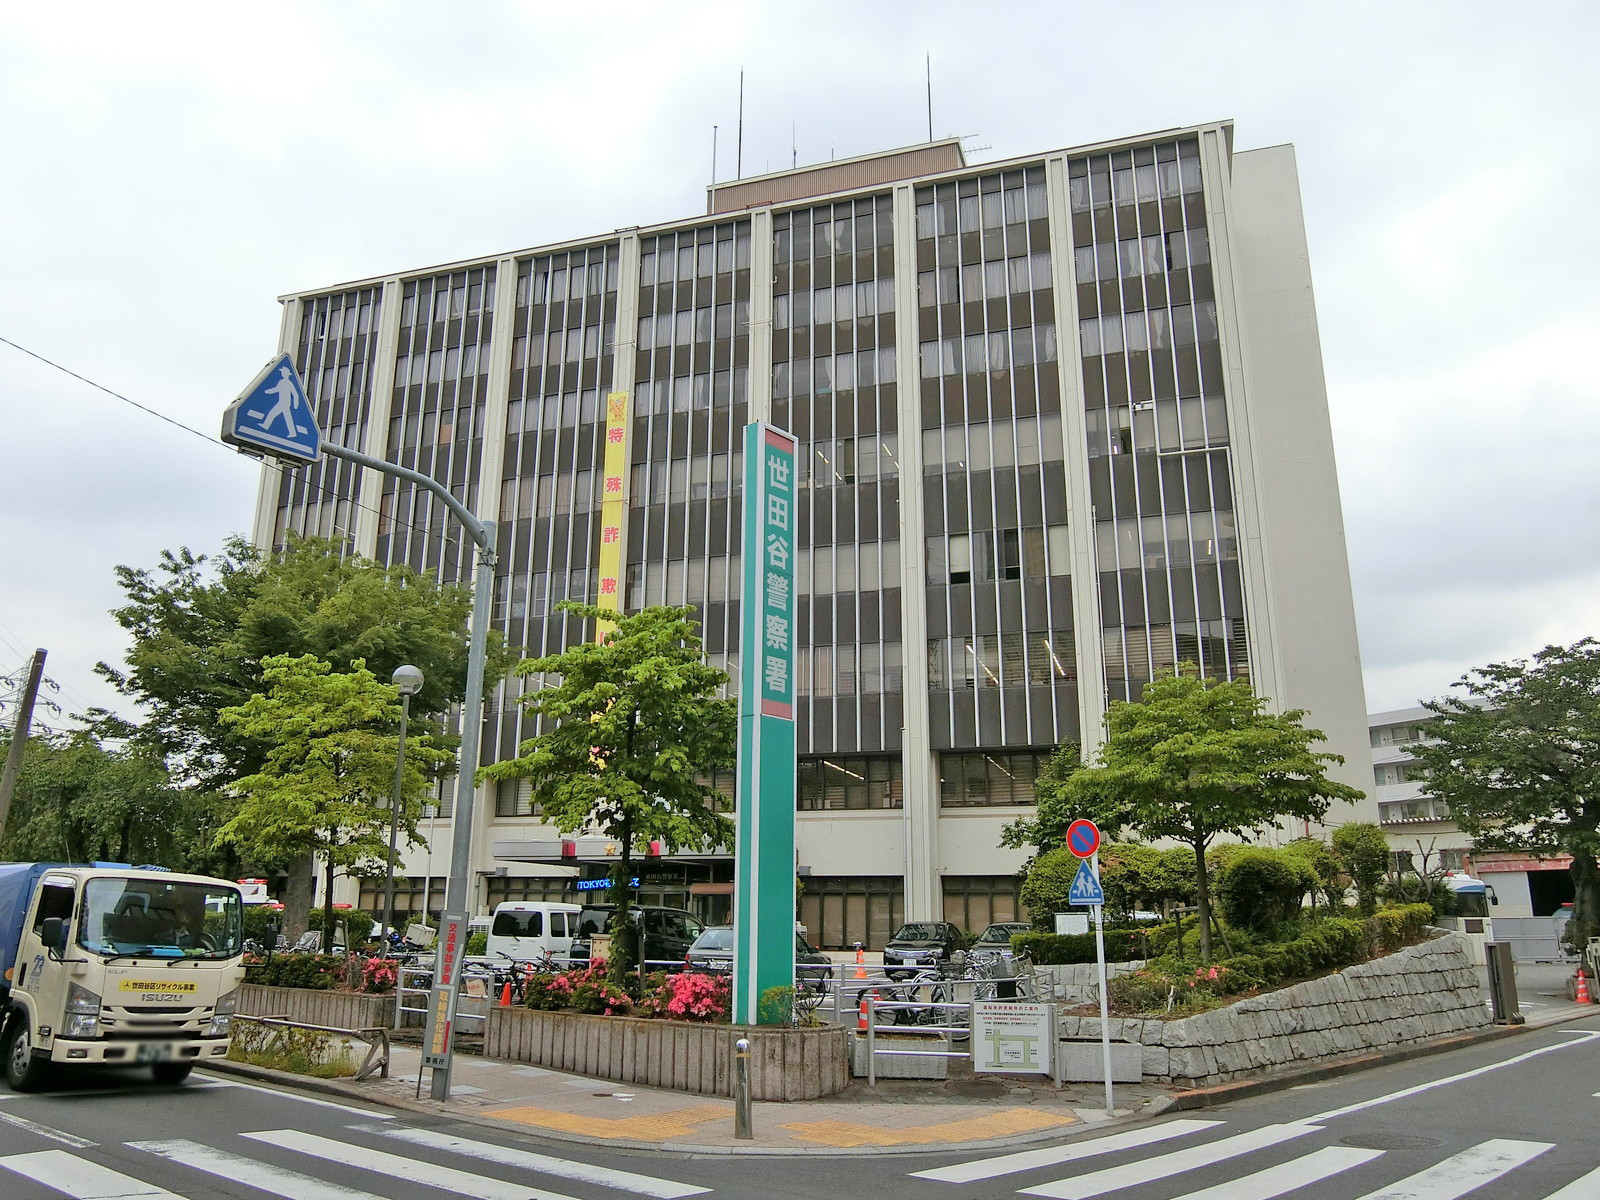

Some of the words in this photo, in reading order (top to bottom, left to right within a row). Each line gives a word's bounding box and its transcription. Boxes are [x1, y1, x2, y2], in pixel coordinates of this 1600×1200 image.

[767, 456, 789, 693] 世田谷警察署
[31, 954, 45, 976] 23
[441, 923, 458, 985] 交通事故多発
[132, 982, 195, 991] 世田谷区リサイクル事業
[141, 994, 183, 1002] ISUZU
[431, 991, 449, 1054] 取締強化路線
[425, 1056, 445, 1065] 警視庁
